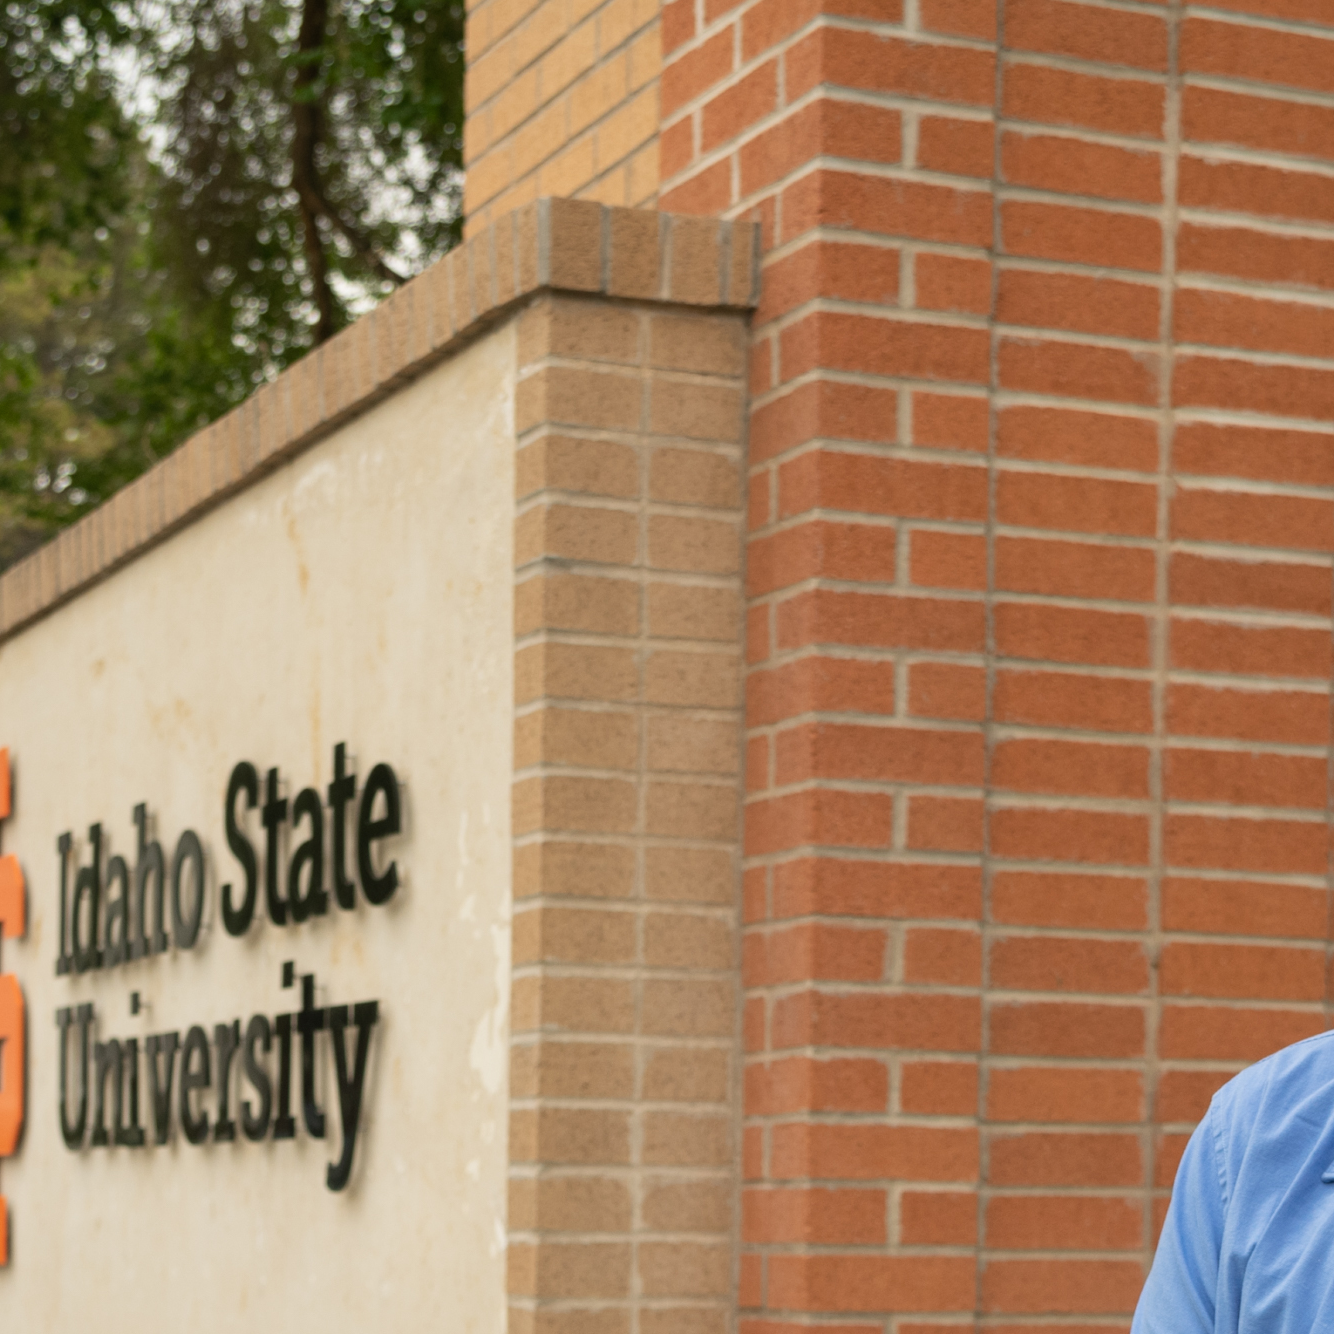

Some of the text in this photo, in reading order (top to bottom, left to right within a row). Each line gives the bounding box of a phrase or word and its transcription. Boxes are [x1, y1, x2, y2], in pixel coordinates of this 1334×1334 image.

[56, 742, 402, 976] Idaho State
[56, 960, 380, 1191] University
